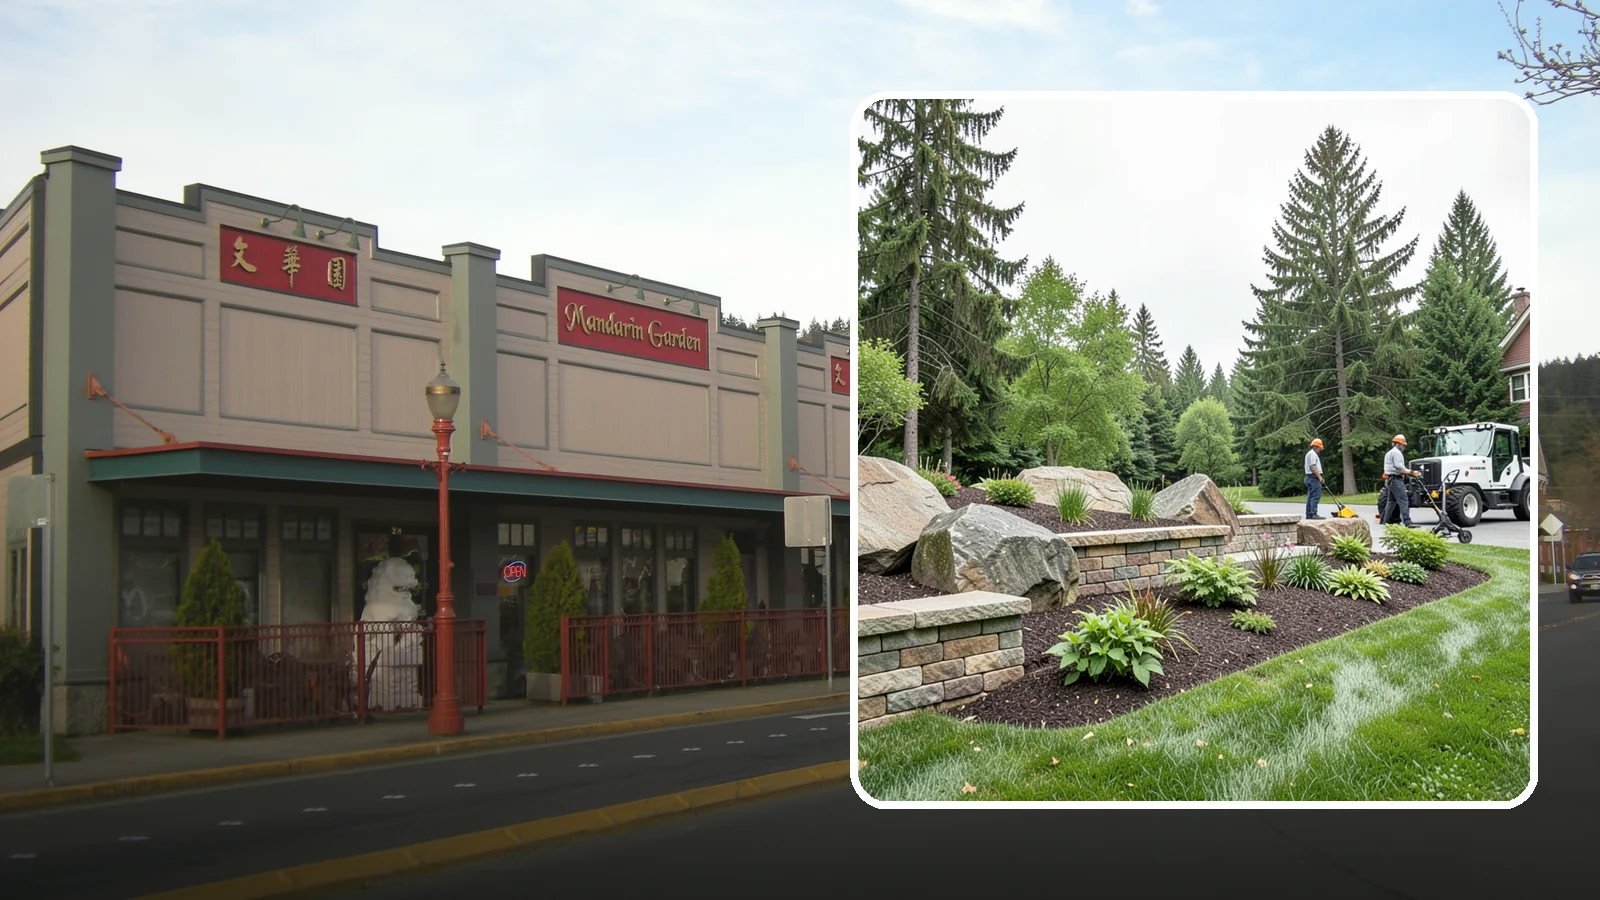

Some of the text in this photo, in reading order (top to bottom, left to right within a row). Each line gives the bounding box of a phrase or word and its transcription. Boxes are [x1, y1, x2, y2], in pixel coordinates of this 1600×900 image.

[231, 235, 346, 291] 文華園
[564, 302, 702, 352] Mandarin Garden
[503, 565, 527, 578] OPEN
